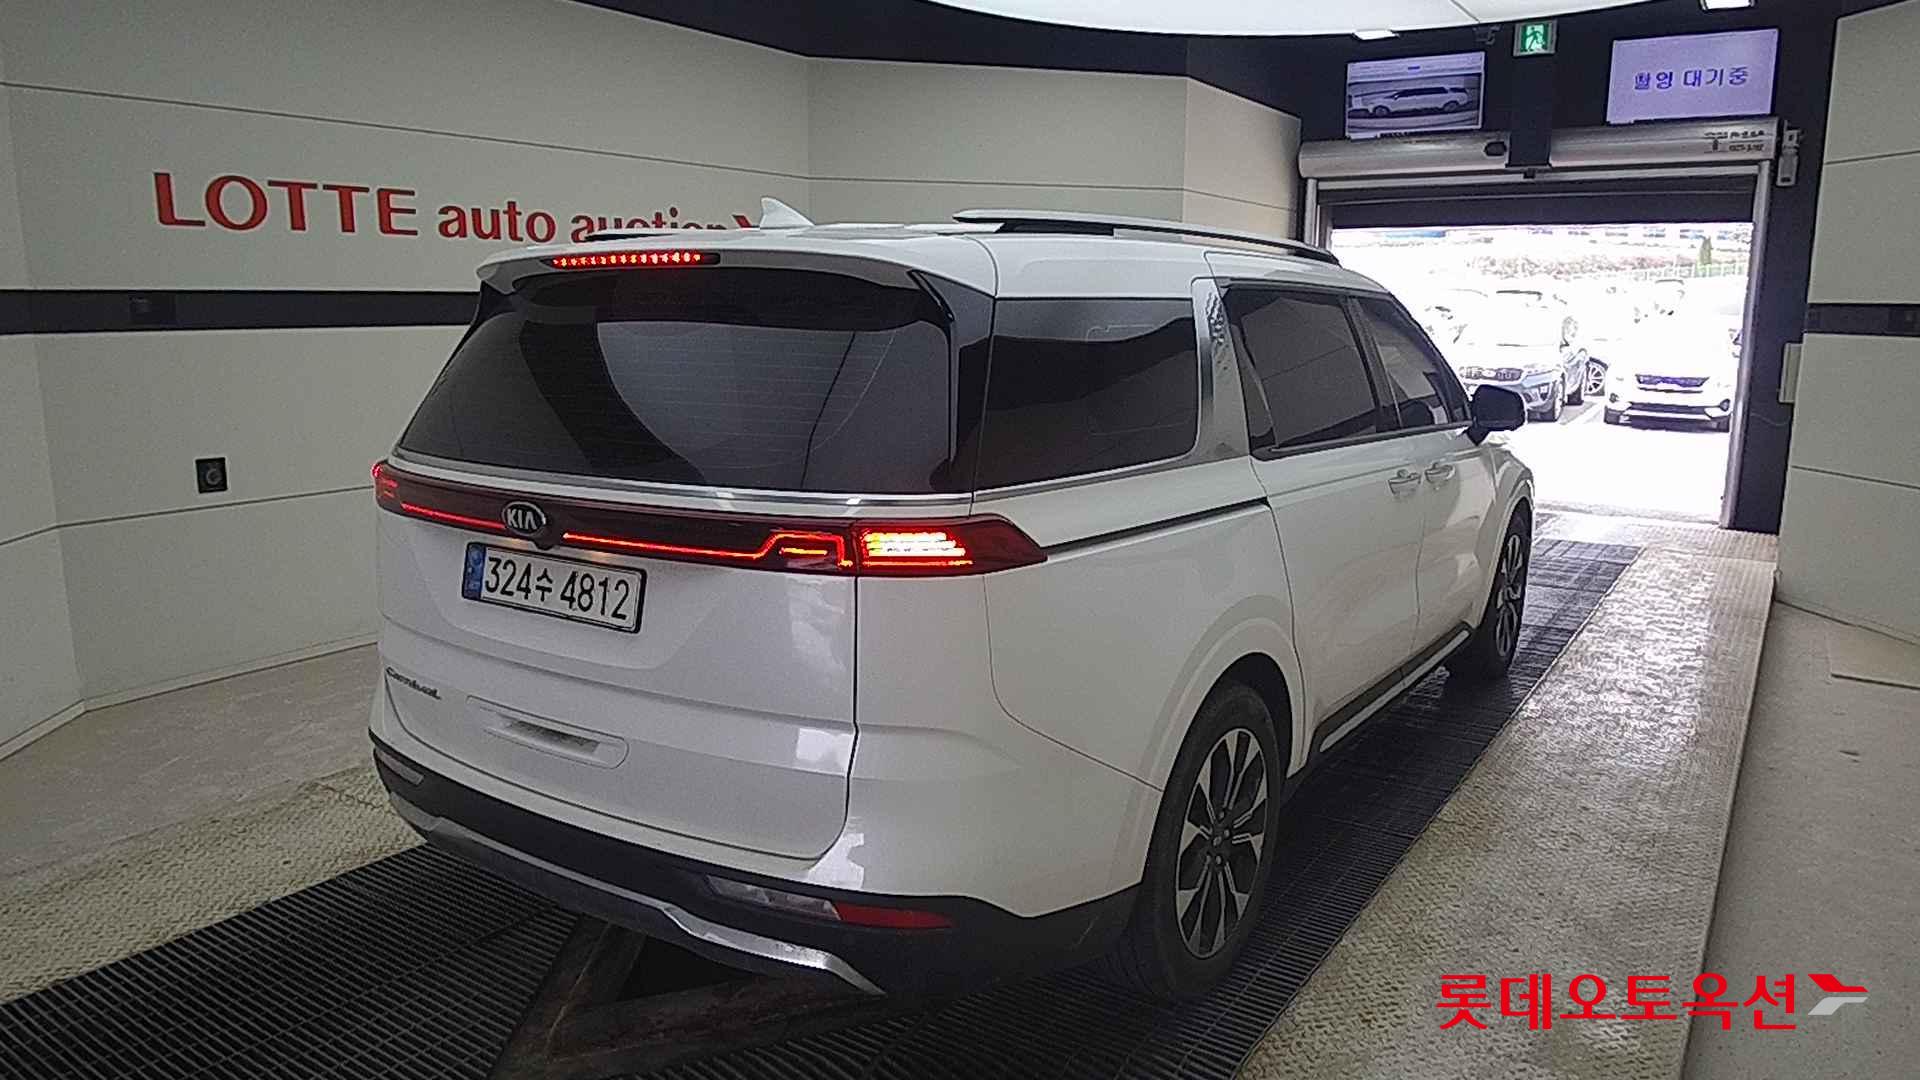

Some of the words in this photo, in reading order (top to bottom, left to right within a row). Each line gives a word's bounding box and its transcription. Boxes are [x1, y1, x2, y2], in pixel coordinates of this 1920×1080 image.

[1682, 66, 1750, 88] 대기중
[154, 171, 419, 236] LOTTE
[437, 200, 556, 243] auto
[506, 509, 538, 531] KIA
[485, 556, 554, 603] 324수
[560, 570, 630, 621] 4812
